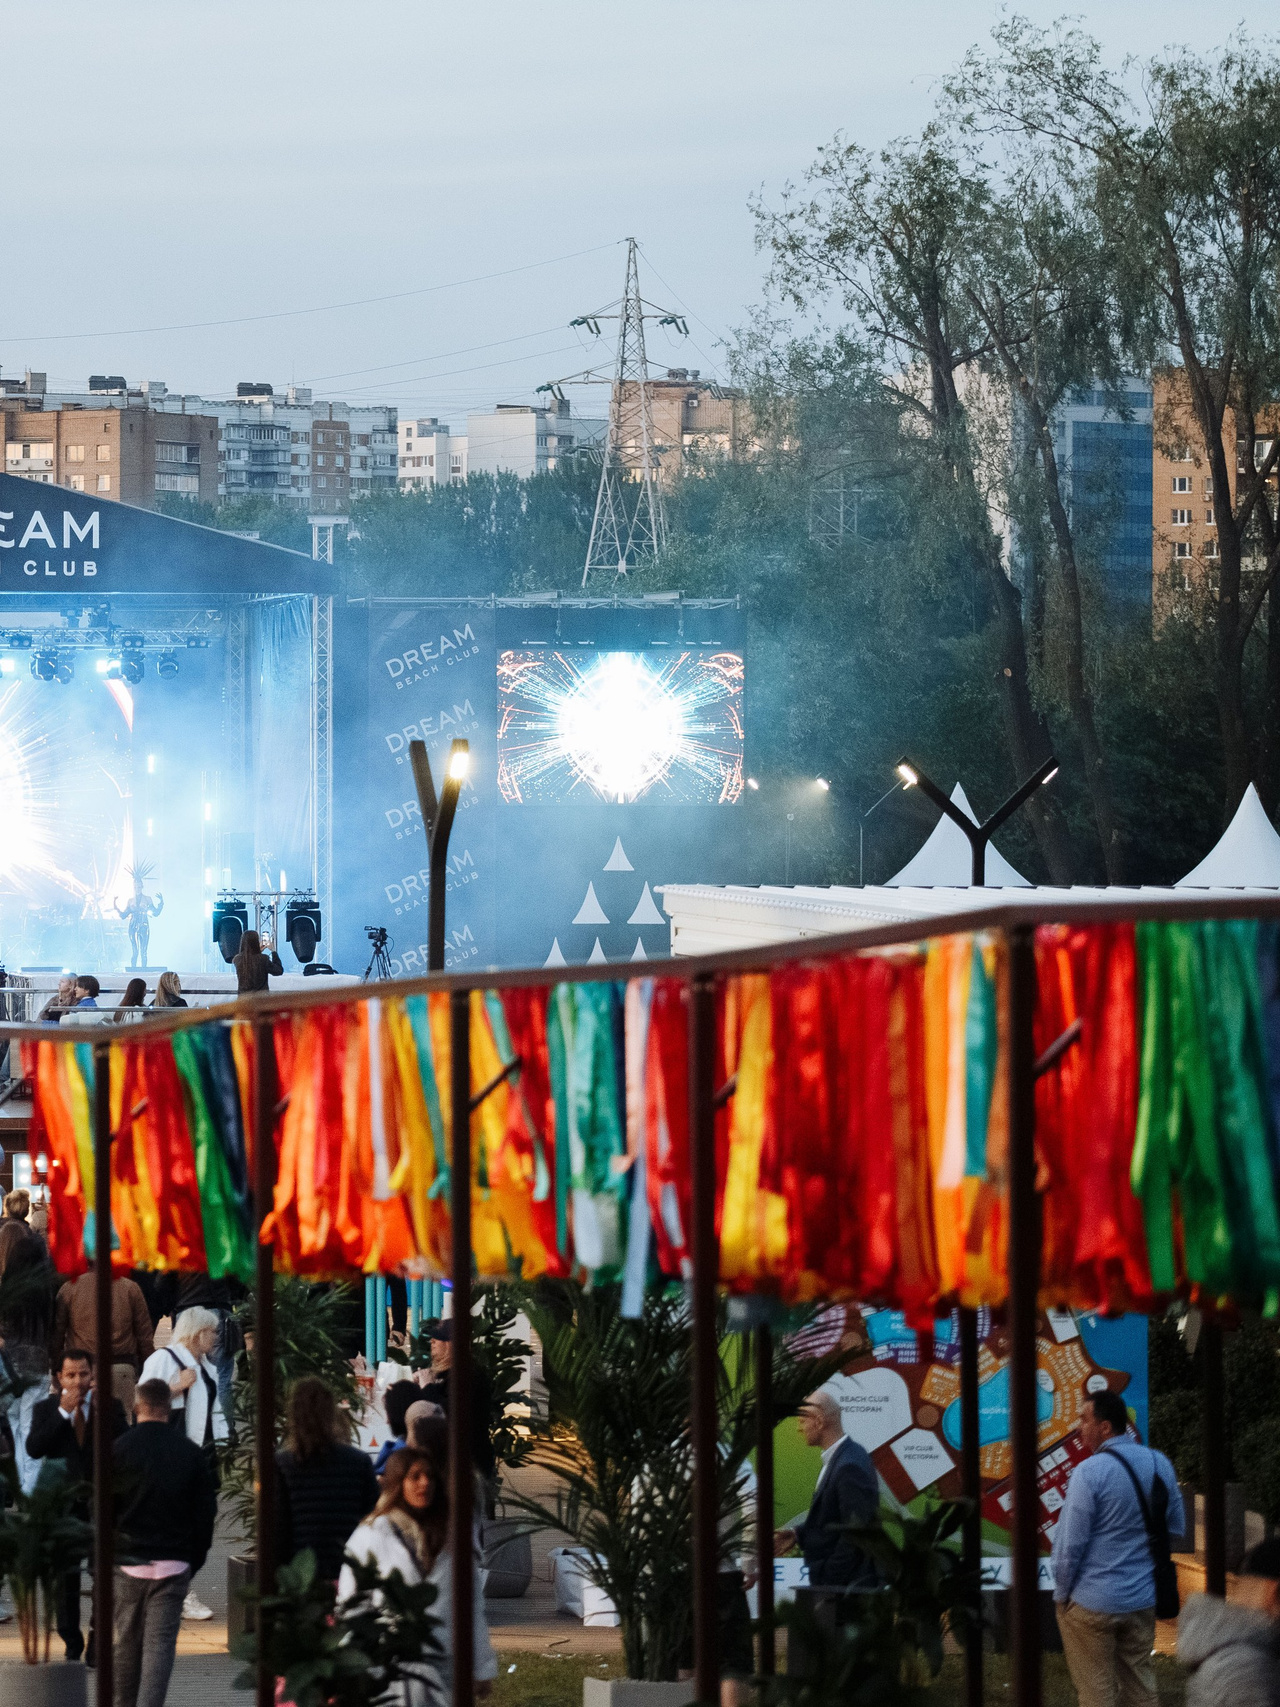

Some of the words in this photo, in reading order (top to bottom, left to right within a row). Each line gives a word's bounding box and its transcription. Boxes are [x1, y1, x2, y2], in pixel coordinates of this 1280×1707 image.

[23, 560, 98, 577] CLUB
[385, 622, 476, 678] DREAM
[395, 664, 439, 690] BEACH
[446, 645, 480, 666] CLUB
[385, 698, 476, 753] DREAM
[446, 720, 480, 741] CLUB
[455, 796, 479, 813] LUB
[394, 895, 429, 916] BEAC
[445, 871, 479, 892] CLUB
[445, 946, 479, 967] CLUB
